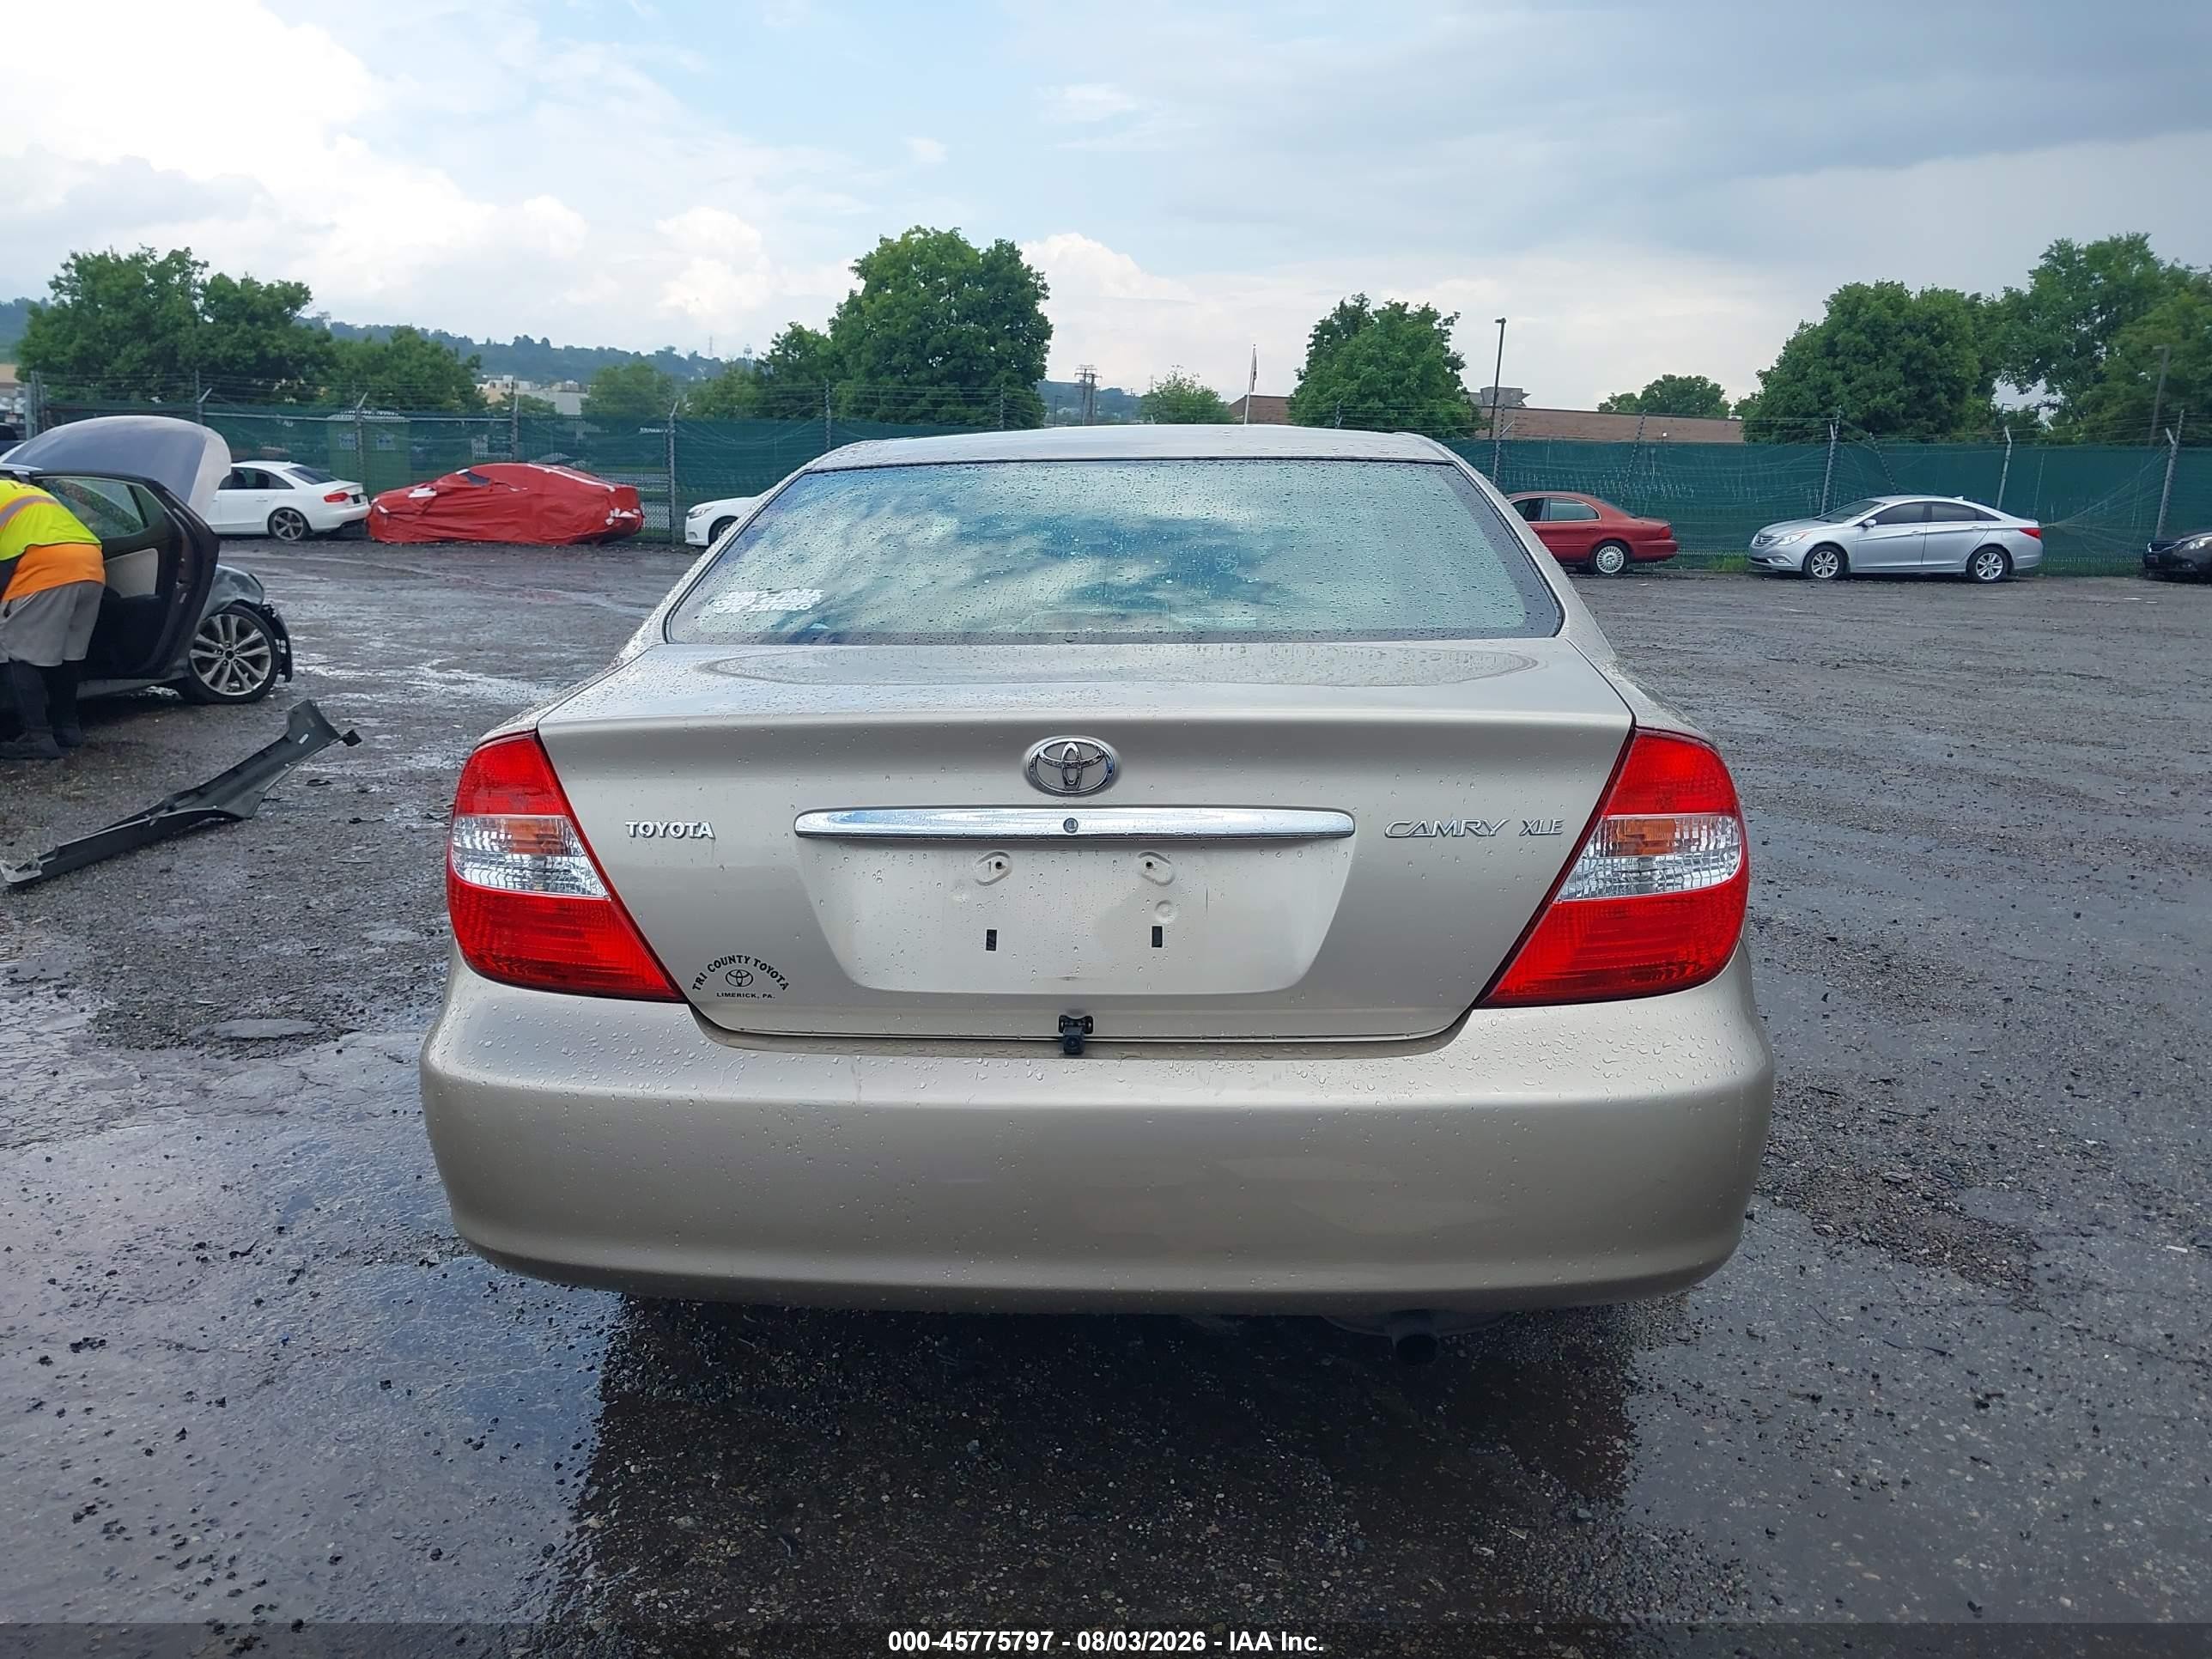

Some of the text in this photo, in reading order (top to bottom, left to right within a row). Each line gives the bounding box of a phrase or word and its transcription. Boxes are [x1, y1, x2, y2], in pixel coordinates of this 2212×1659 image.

[625, 821, 715, 839] TOYOTA
[1384, 818, 1565, 838] CAMRY XLE
[692, 955, 790, 991] TRI COUNTY TOYOTA
